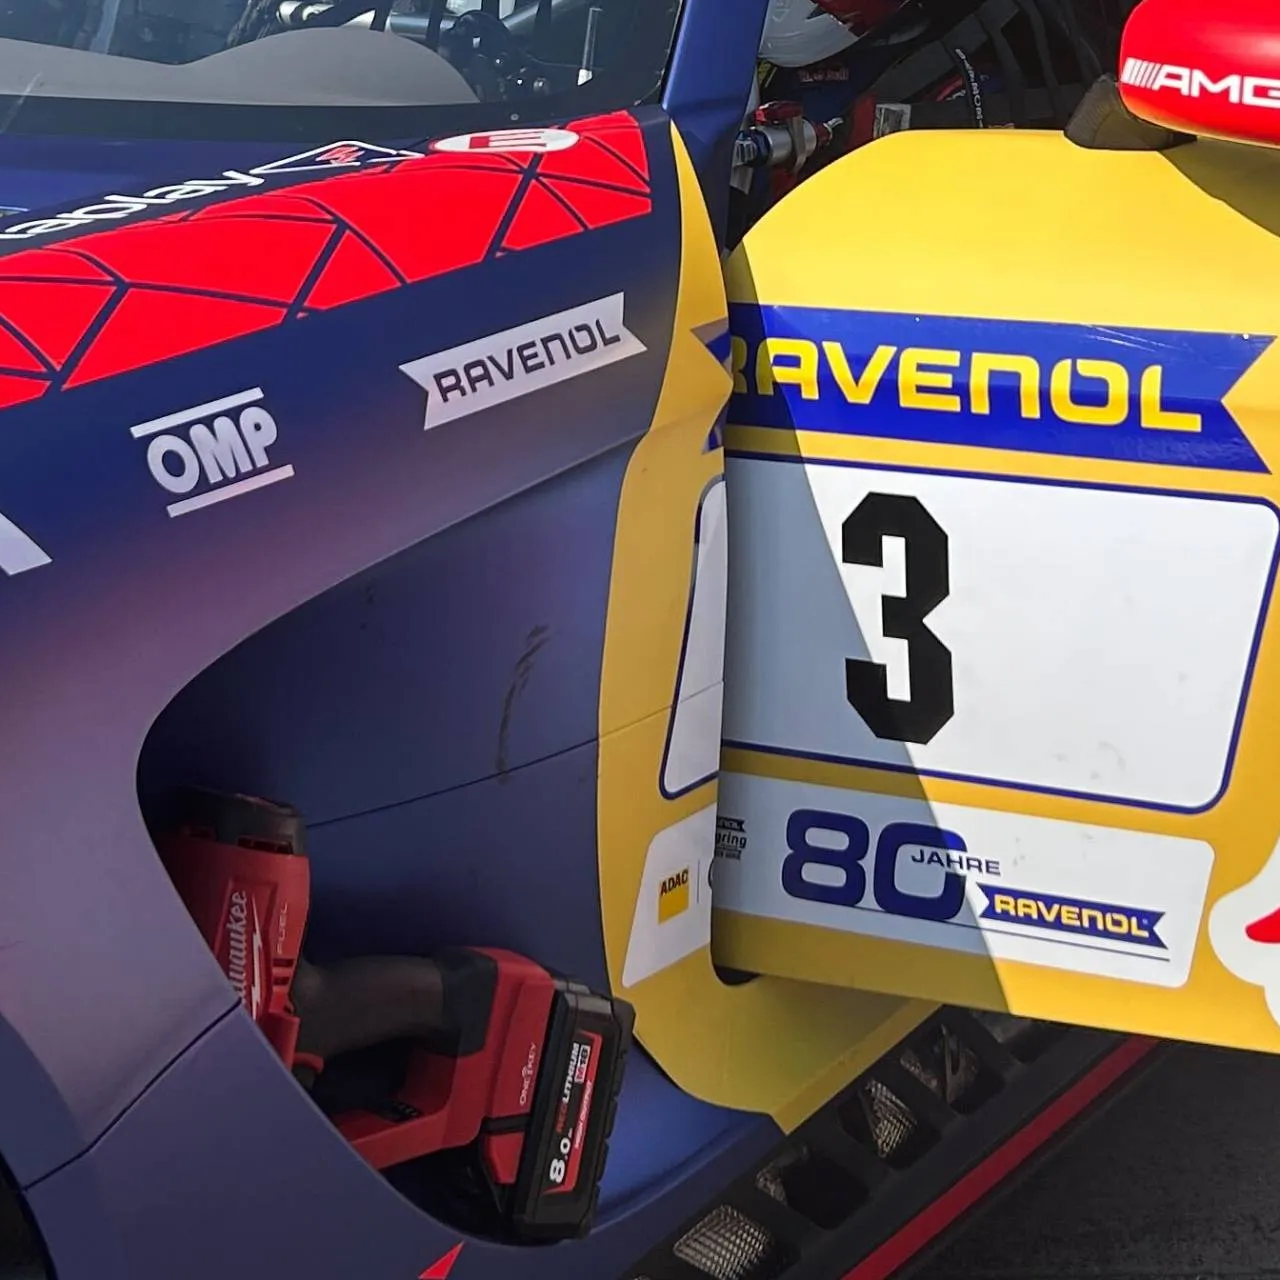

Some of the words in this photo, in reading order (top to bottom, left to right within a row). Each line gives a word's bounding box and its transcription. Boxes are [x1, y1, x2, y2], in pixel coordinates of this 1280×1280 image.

[432, 318, 622, 404] RAVENOL
[727, 336, 1203, 433] AVENOL
[146, 405, 280, 496] OMP
[841, 491, 955, 745] 3
[660, 868, 689, 896] ADAC
[781, 808, 968, 921] 80
[910, 847, 1002, 876] JAHRE
[276, 901, 288, 956] FUEL
[993, 893, 1151, 938] RAVENOL
[549, 1136, 571, 1184] 8.0
